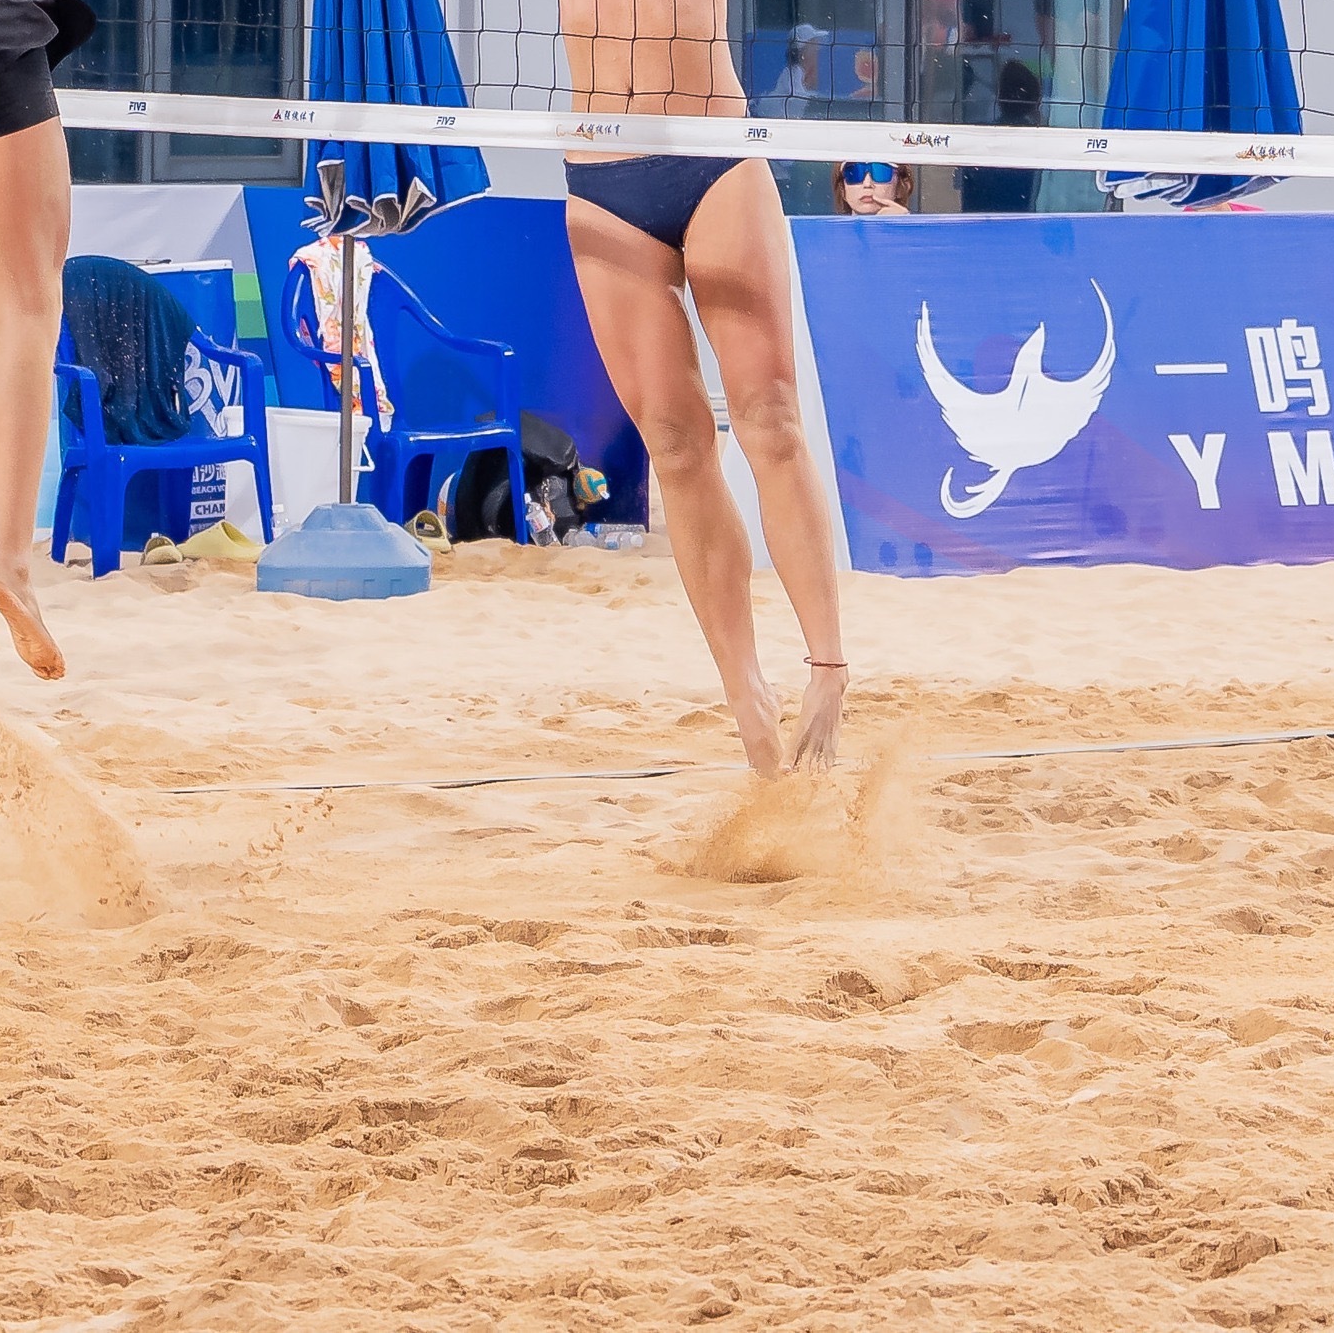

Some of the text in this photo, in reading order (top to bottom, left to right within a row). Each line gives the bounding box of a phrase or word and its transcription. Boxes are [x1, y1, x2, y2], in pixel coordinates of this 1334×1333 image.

[128, 101, 146, 111] FIVB
[437, 116, 455, 125] FIVB
[747, 128, 767, 138] FIVB
[1087, 139, 1107, 149] FIVB
